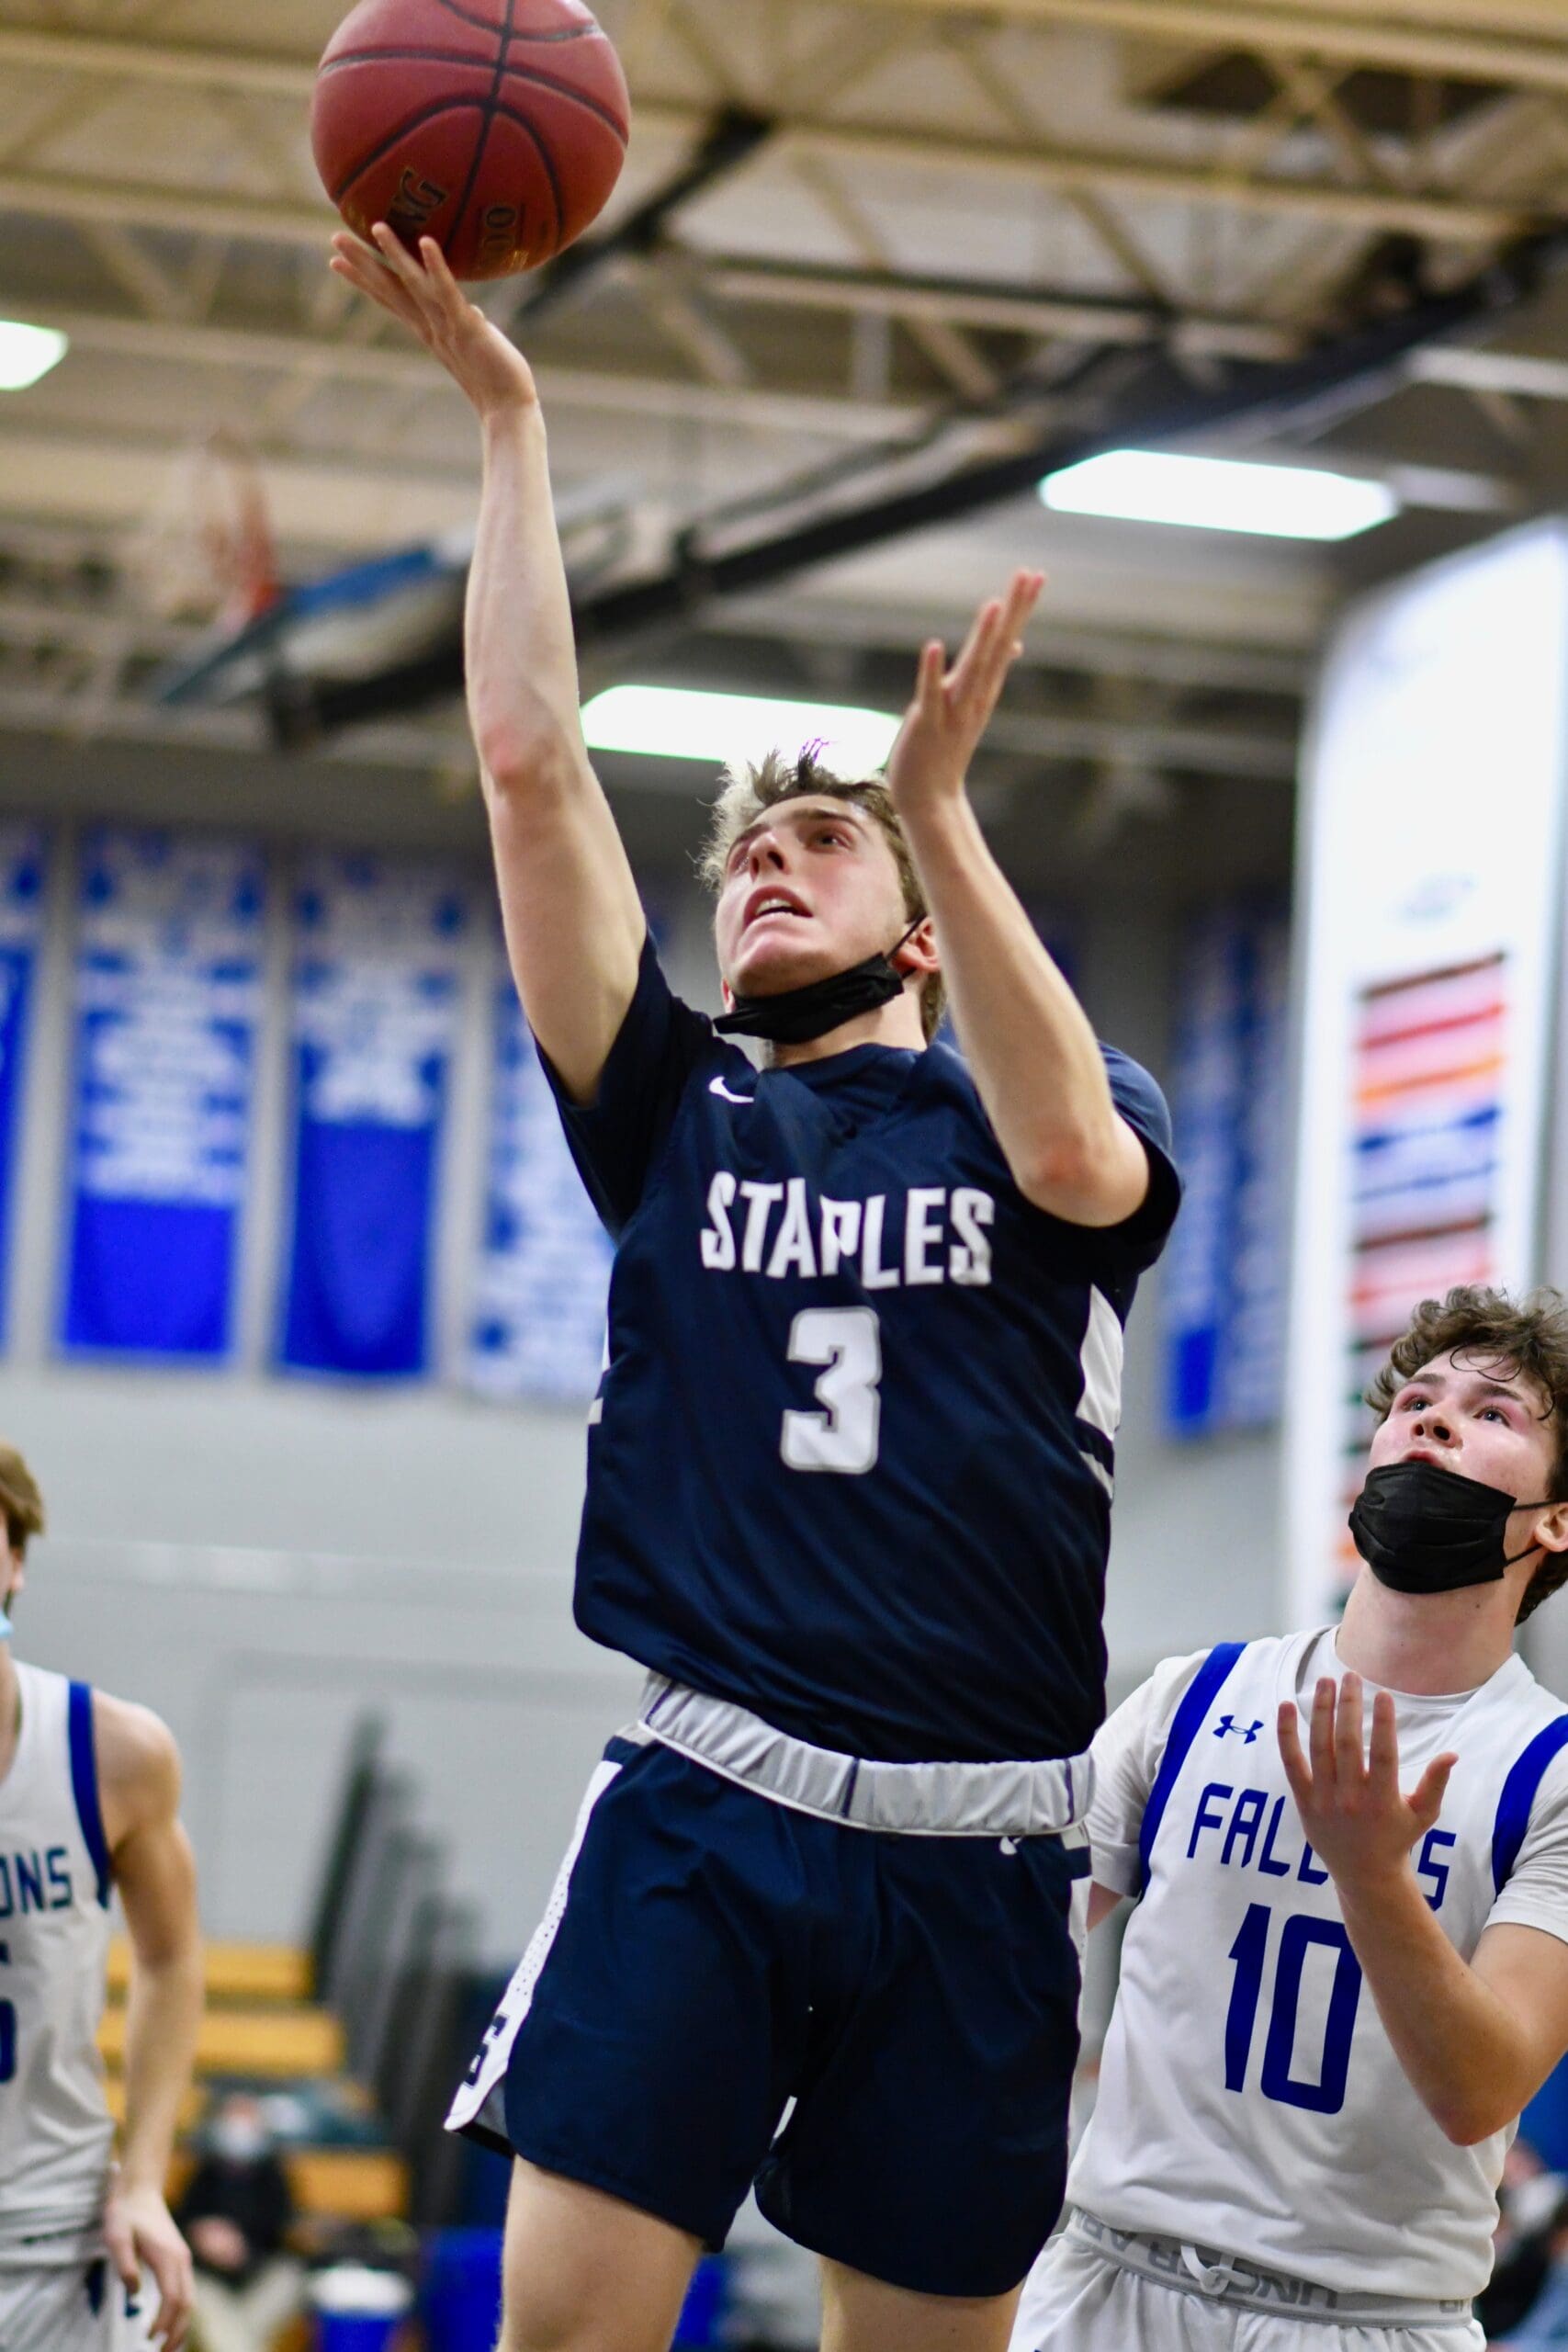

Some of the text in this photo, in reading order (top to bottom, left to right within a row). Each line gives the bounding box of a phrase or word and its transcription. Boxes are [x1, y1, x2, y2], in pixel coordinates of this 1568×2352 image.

[699, 1171, 995, 1290] STAPLES
[779, 1305, 882, 1475] 3
[1224, 1903, 1363, 2115] 10
